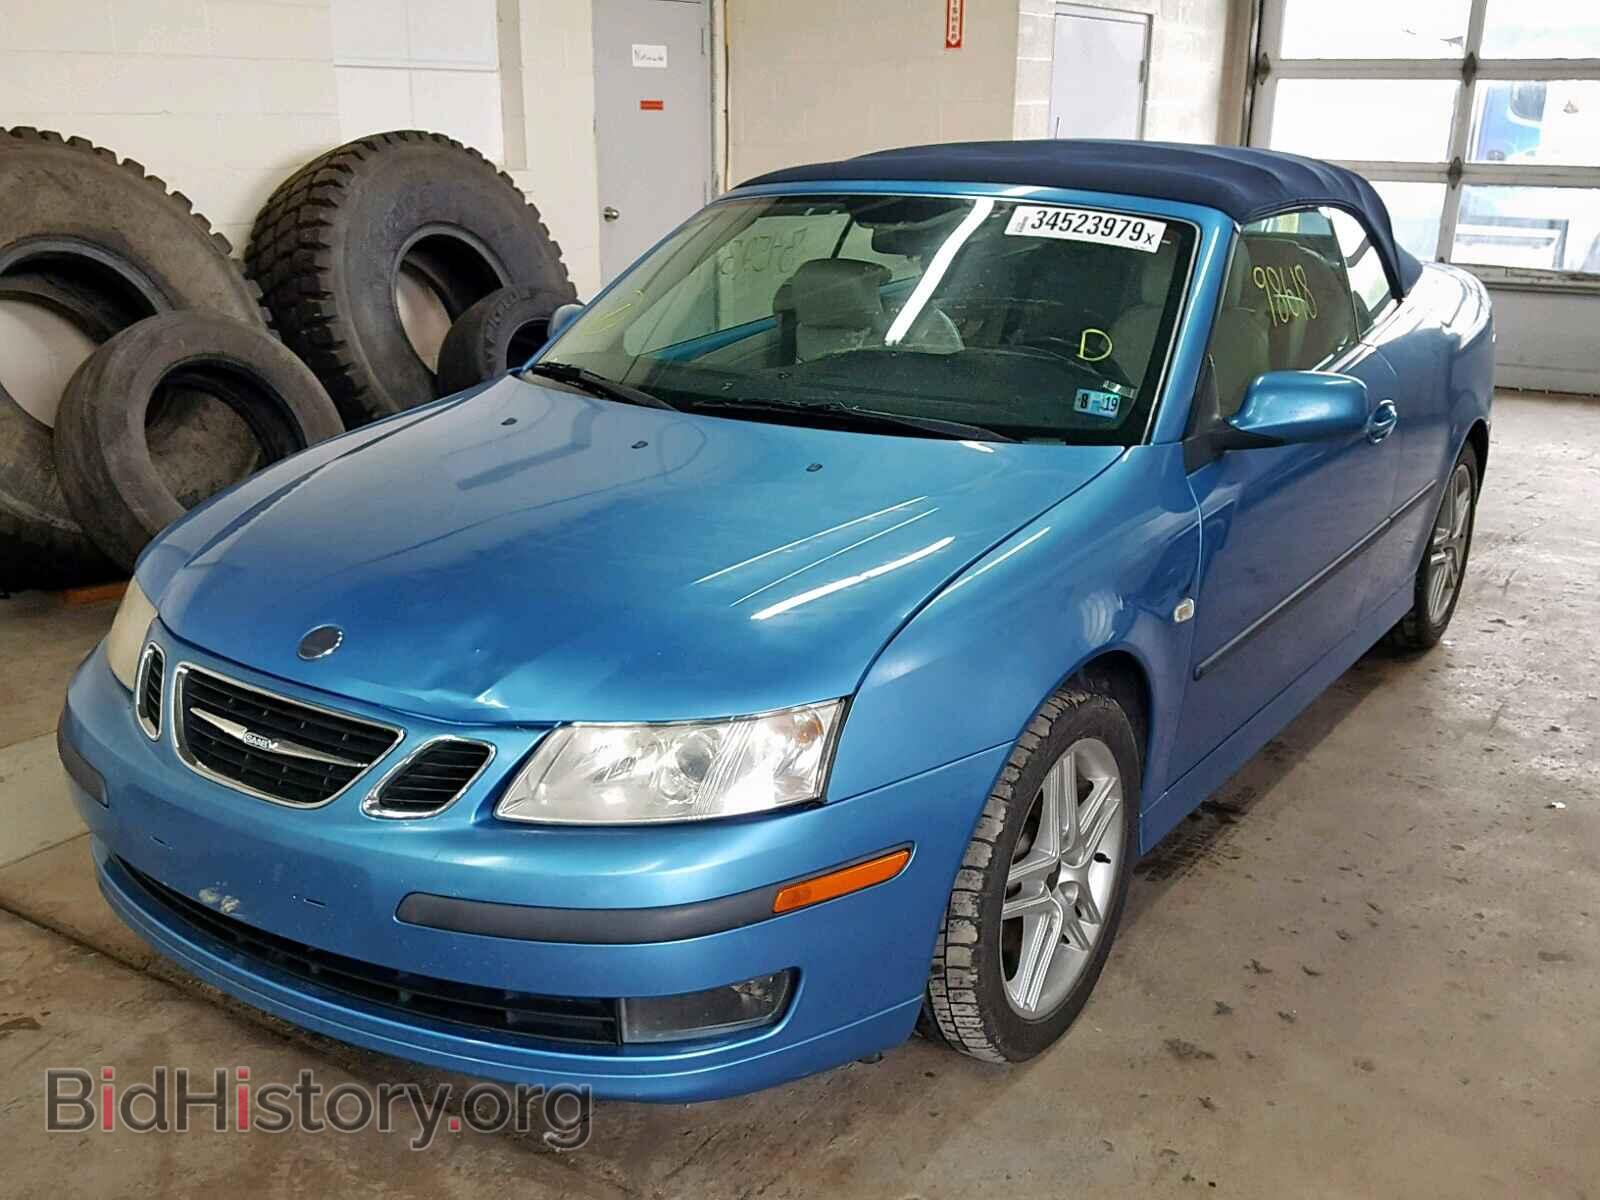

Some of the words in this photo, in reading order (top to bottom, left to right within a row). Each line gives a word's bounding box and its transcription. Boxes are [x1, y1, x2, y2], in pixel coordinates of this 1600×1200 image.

[1031, 210, 1146, 242] 34523979
[1076, 328, 1113, 362] D
[1080, 392, 1090, 409] 8
[1103, 396, 1119, 412] 19
